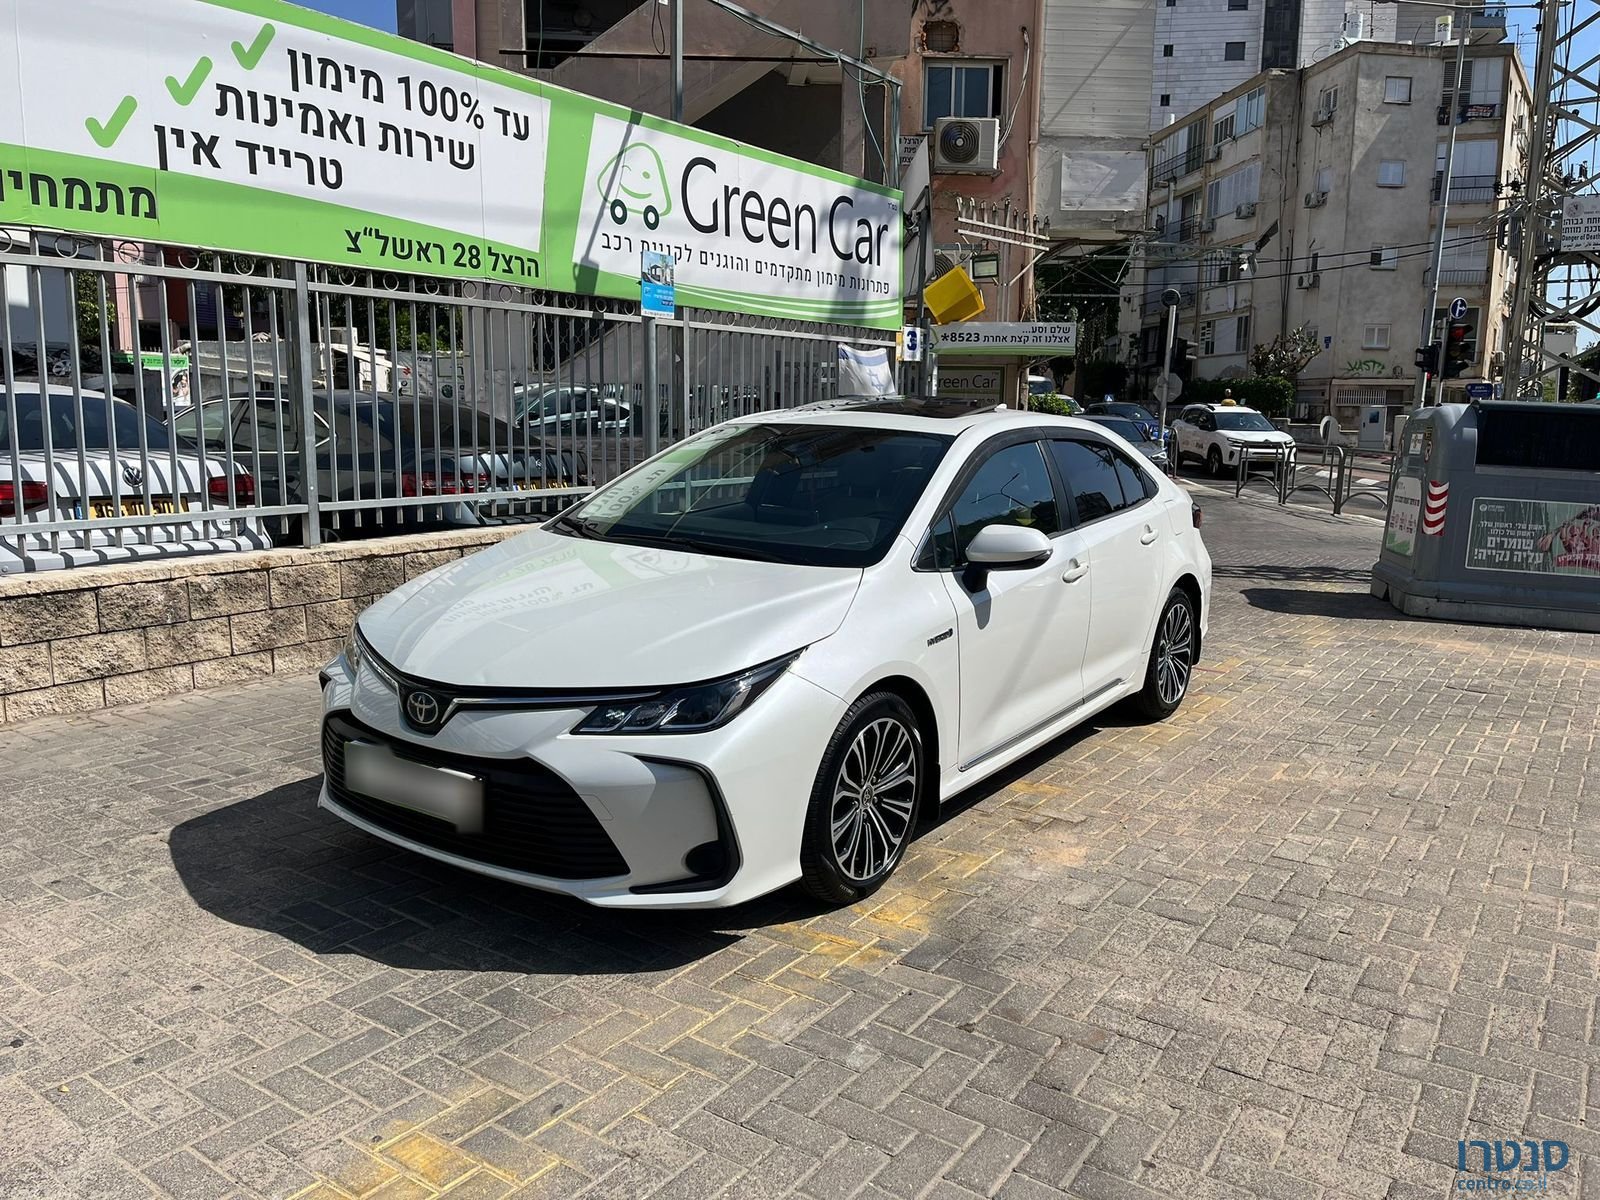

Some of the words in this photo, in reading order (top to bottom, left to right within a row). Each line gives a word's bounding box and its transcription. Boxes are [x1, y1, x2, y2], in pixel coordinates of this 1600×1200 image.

[287, 48, 384, 104] מימון
[215, 83, 366, 147] ואמינות
[397, 76, 484, 130] 100%
[493, 106, 529, 141] עד
[154, 124, 221, 171] אין
[378, 121, 475, 170] שירות
[235, 139, 343, 190] טרייד
[0, 168, 157, 220] מתמחי
[681, 156, 817, 254] Green
[829, 195, 888, 267] Car
[601, 232, 633, 253] רכב
[452, 242, 481, 270] 28
[487, 246, 540, 278] הרצל
[700, 250, 749, 272] והוגנים
[755, 260, 812, 283] מתקדמים
[816, 270, 845, 288] מימון
[849, 275, 890, 294] פתרונות
[982, 335, 1008, 343] אחרת
[1009, 335, 1030, 344] קצת
[1032, 335, 1043, 343] זה
[1046, 335, 1071, 344] אצלנו
[1050, 325, 1071, 334] שלם
[938, 376, 969, 389] reen
[972, 374, 996, 389] Car
